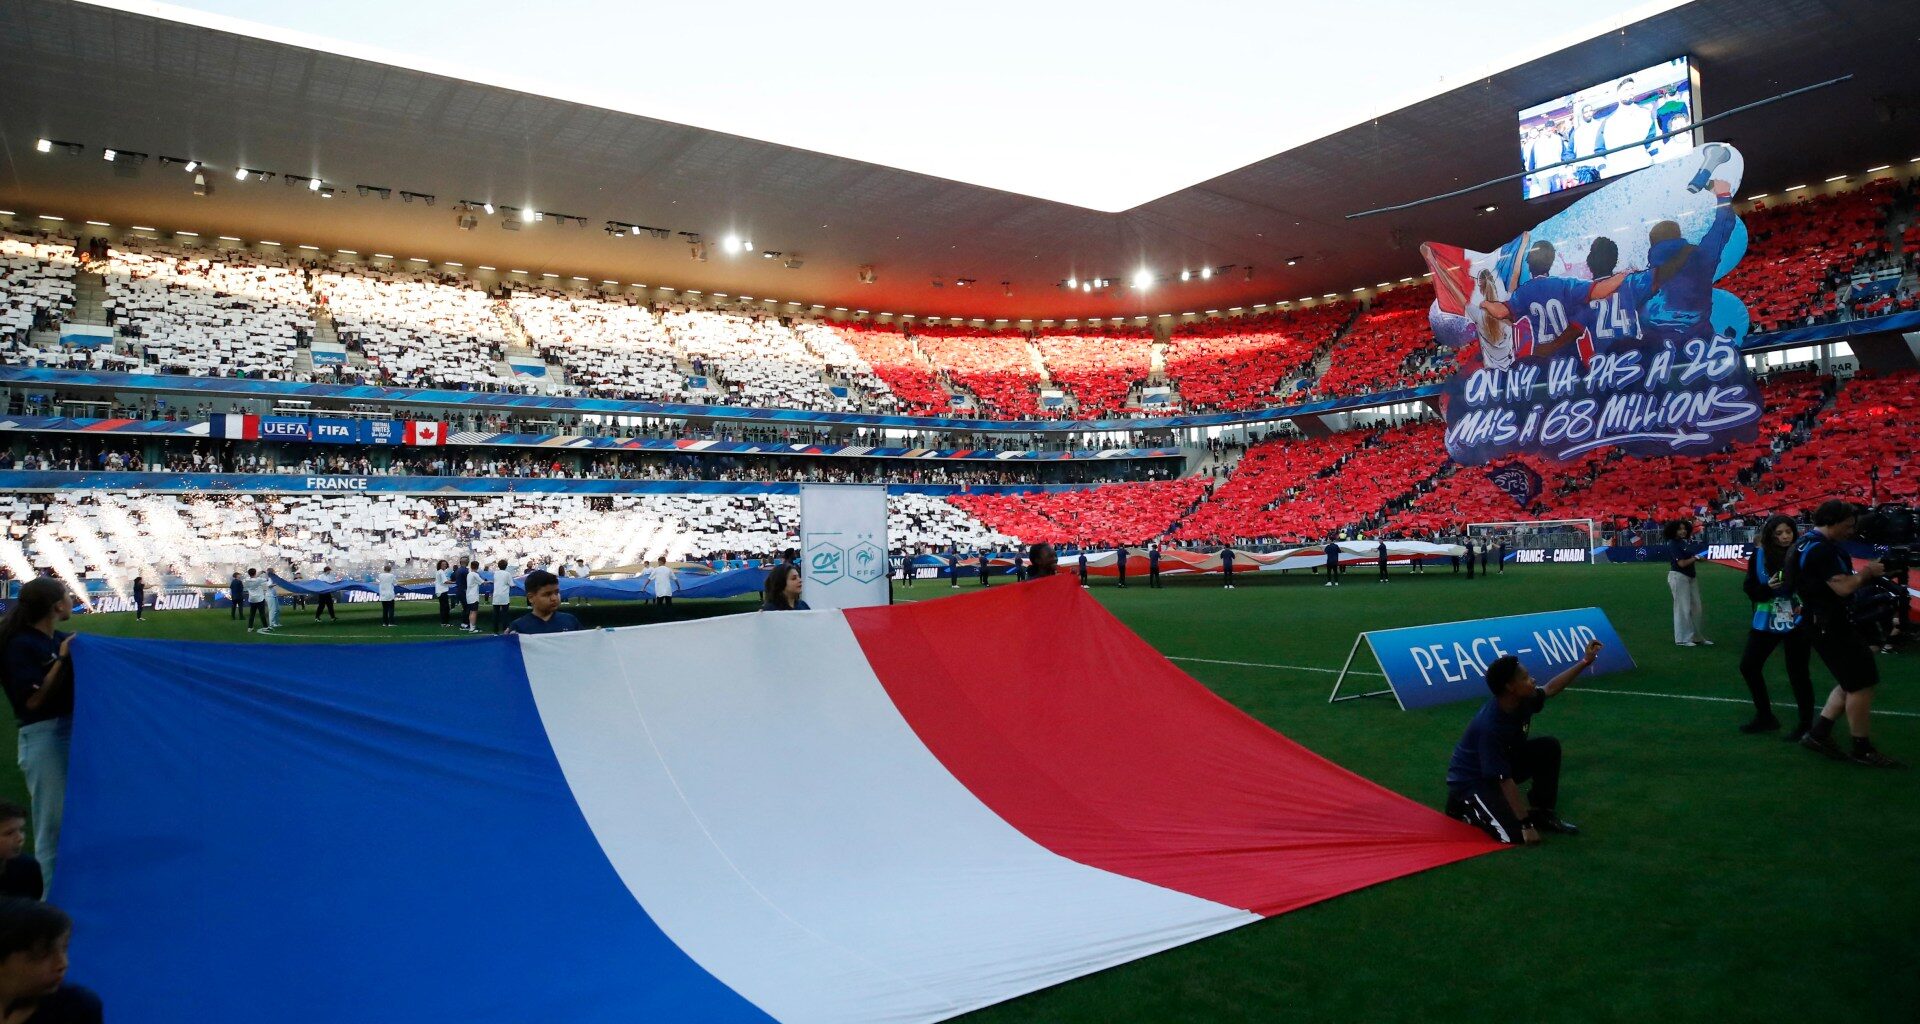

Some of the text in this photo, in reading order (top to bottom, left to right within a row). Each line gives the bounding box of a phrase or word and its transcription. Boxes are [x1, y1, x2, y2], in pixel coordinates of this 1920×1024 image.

[1529, 298, 1569, 344] 20
[1589, 292, 1631, 339] 24
[1466, 368, 1500, 403] ON
[1549, 357, 1577, 395] VA
[1585, 351, 1641, 390] PAS
[1680, 335, 1735, 381] 25
[1541, 400, 1597, 441] 68
[264, 422, 307, 435] UEFA
[318, 425, 350, 436] FIFA
[306, 477, 368, 489] FRANCE
[1516, 549, 1545, 562] FRANCE
[1553, 549, 1585, 561] CANADA
[1707, 545, 1744, 559] FRANCE
[916, 568, 938, 578] CANADA
[349, 590, 380, 602] FRANC
[97, 596, 139, 613] FRANC
[155, 594, 199, 610] CANADA
[1410, 636, 1509, 686] PEACE
